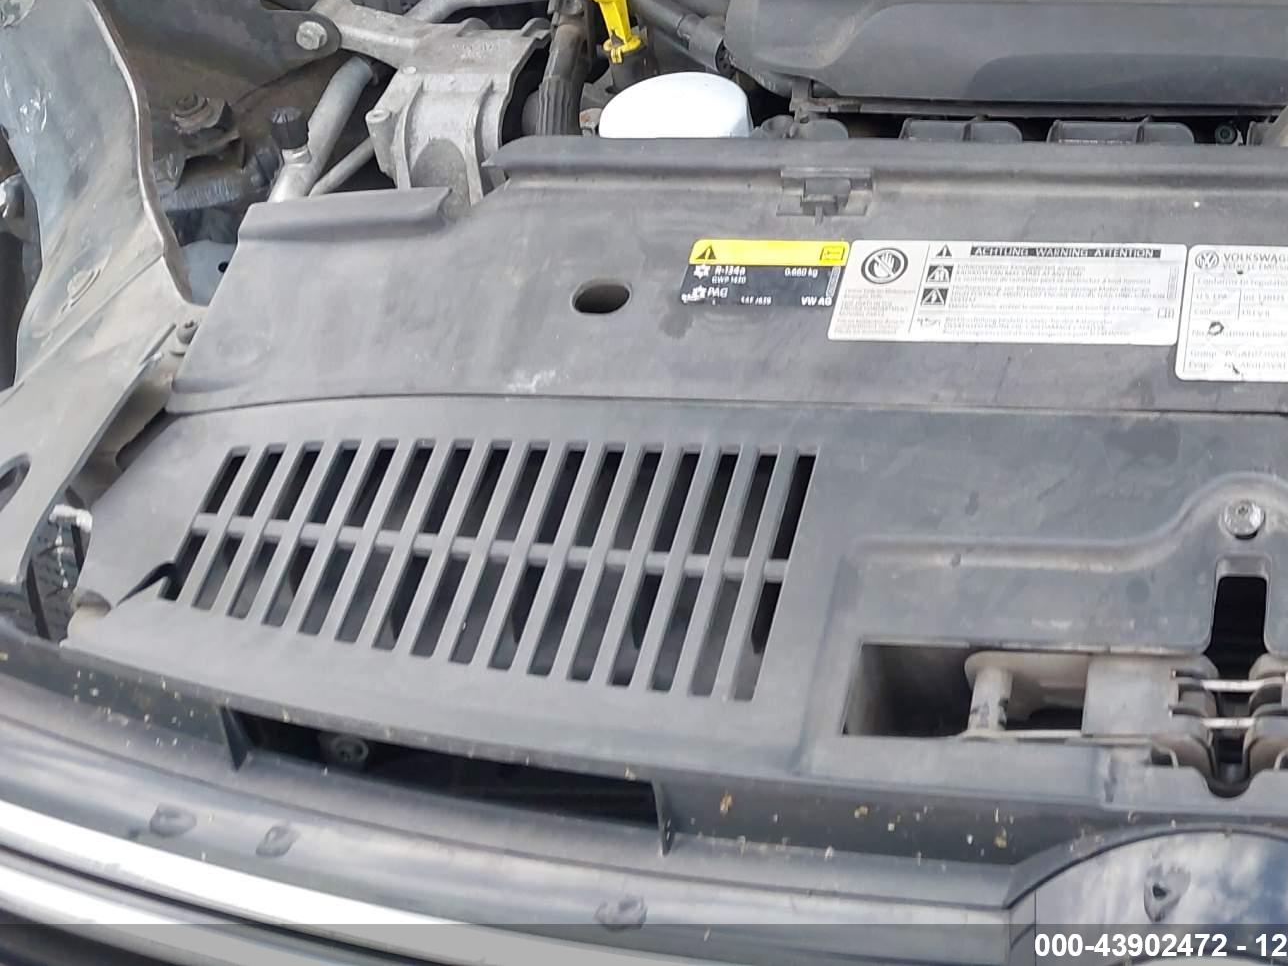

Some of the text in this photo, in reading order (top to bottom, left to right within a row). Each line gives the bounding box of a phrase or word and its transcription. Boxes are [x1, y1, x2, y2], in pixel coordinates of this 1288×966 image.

[974, 246, 1154, 258] ACHTUNG WARNING ATTENTION
[807, 268, 818, 278] kg
[707, 287, 728, 298] PAG
[801, 296, 832, 306] VW AG
